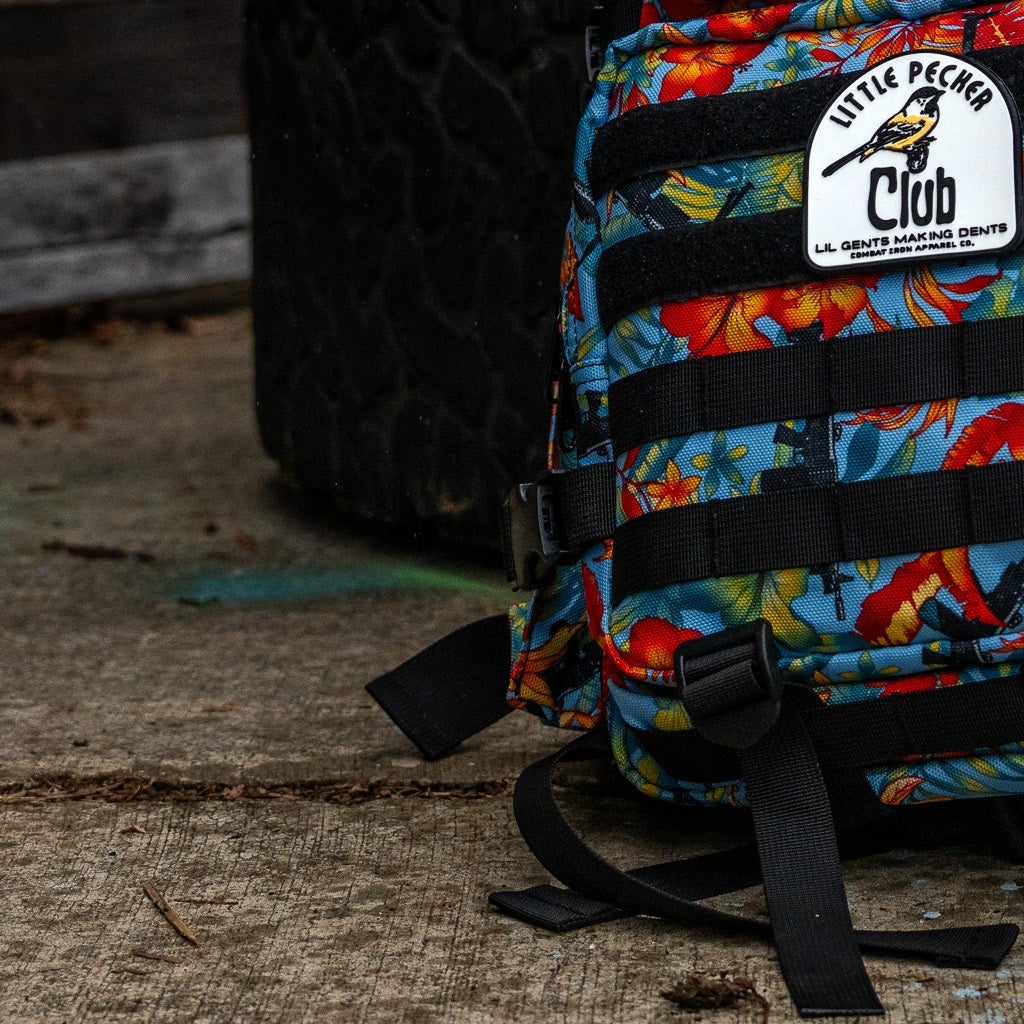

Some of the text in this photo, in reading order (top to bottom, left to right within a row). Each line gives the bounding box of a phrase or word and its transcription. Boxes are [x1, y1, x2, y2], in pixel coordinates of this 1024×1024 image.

[829, 60, 993, 128] LITTLE PECKER
[867, 166, 956, 231] Club
[815, 222, 1008, 253] LIL GENTS MAKING DENTS
[850, 239, 975, 259] COMBAT IRON APPAREL CO.
